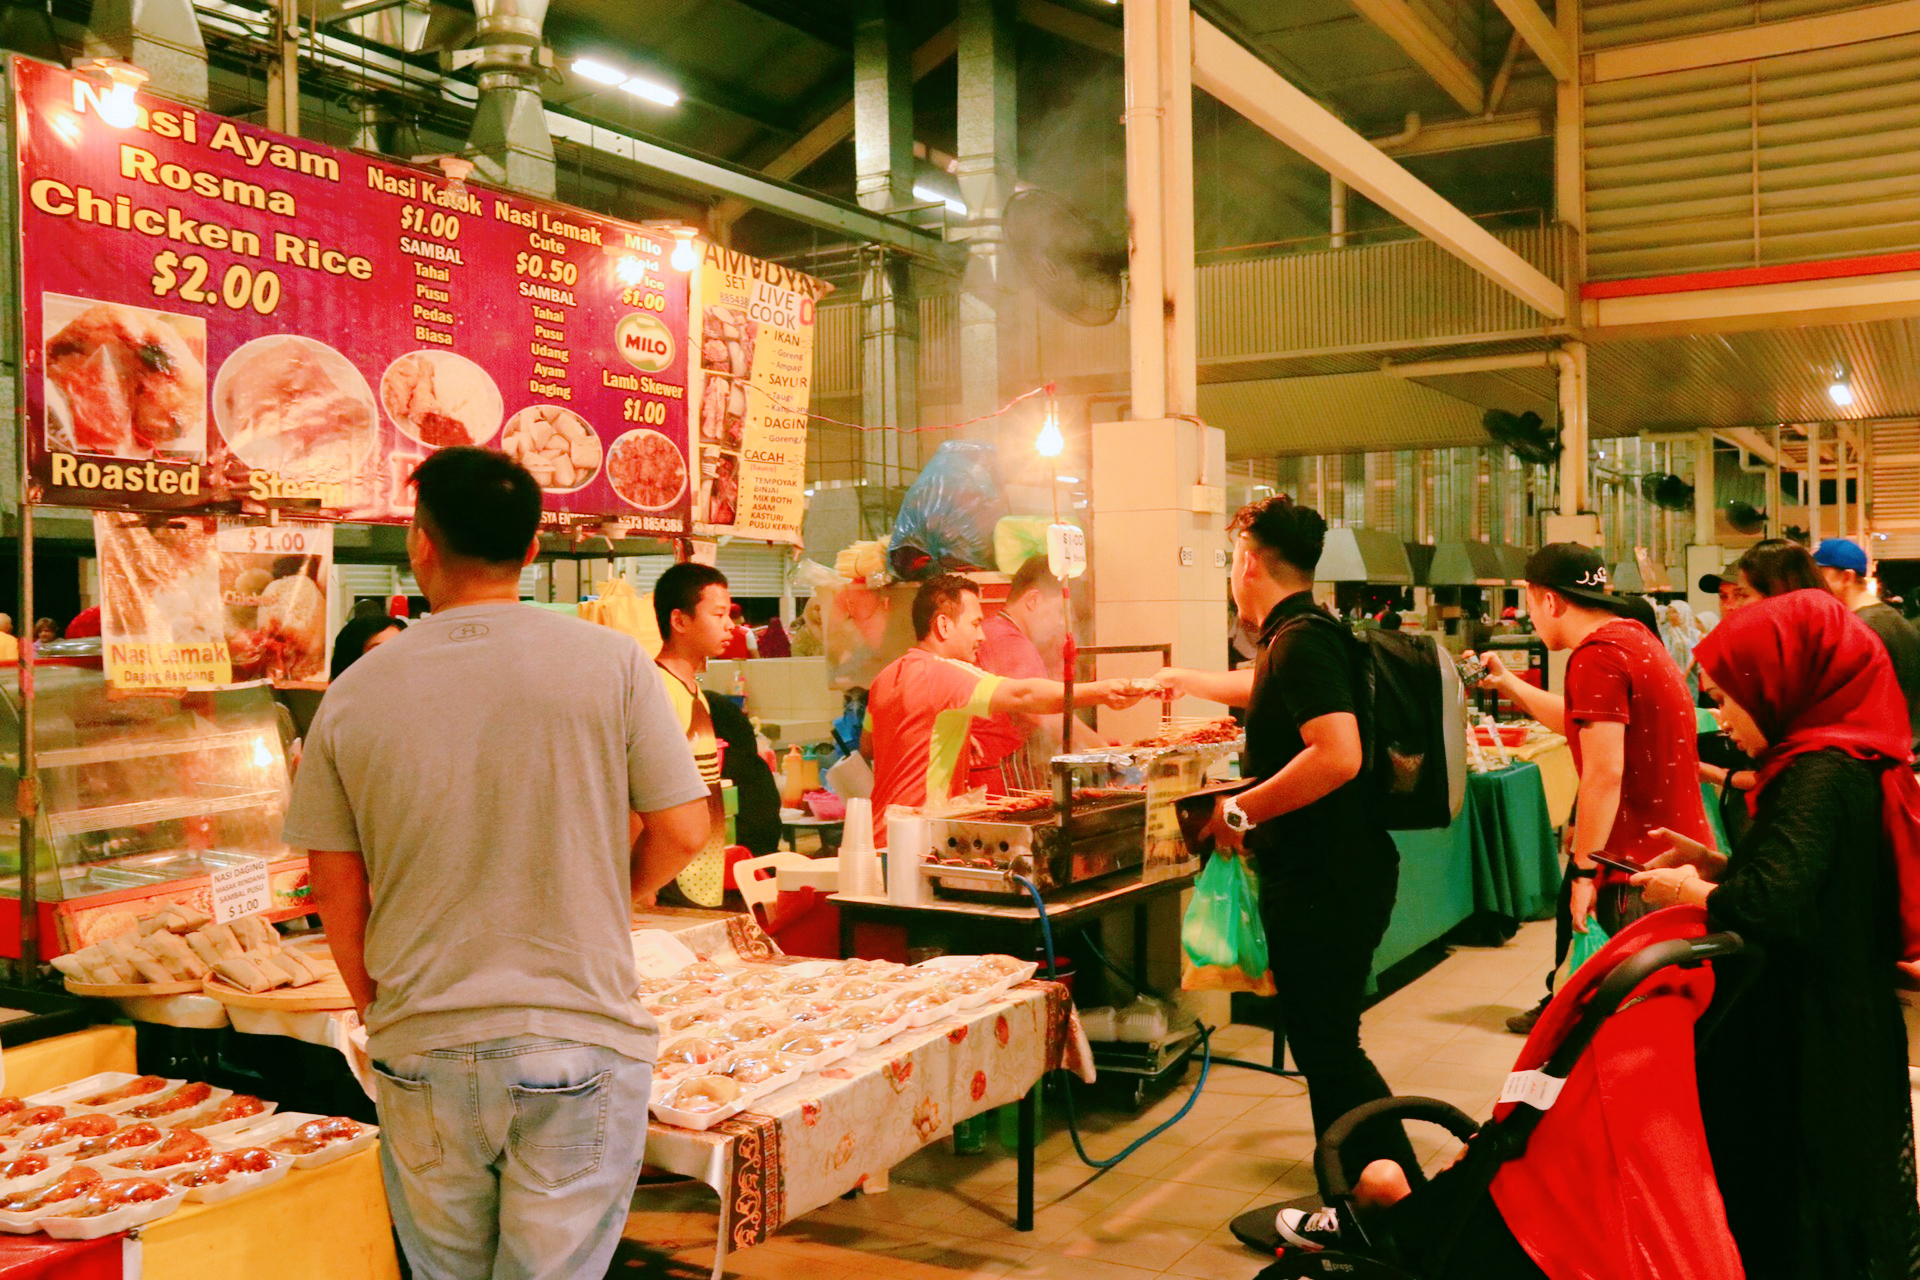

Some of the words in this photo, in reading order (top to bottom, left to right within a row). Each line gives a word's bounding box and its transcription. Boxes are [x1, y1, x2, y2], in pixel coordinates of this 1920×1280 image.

[209, 122, 340, 182] Ayam
[120, 145, 296, 217] Rosma
[367, 166, 416, 199] Nasi
[30, 180, 260, 256] Chicken
[275, 232, 373, 280] Rice
[401, 205, 460, 240] $1.00
[495, 201, 537, 229] Nasi
[542, 214, 602, 246] Lemak
[400, 237, 464, 265] SAMBAL
[529, 233, 565, 254] Cute
[624, 233, 662, 256] Milo
[414, 262, 449, 281] Tahai
[516, 252, 577, 286] $0.50
[152, 250, 281, 314] $2.00
[645, 275, 665, 291] Ice
[725, 274, 745, 290] SET
[416, 284, 449, 302] Pusu
[519, 282, 577, 306] SAMBAL
[623, 288, 665, 313] $1.00
[759, 284, 794, 310] LIVE
[413, 304, 454, 324] Pedas
[532, 305, 564, 323] Tahai
[750, 303, 796, 330] COOK
[415, 326, 453, 345] Biasa
[535, 325, 564, 341] Pusu
[774, 330, 800, 347] IKAN
[531, 342, 569, 363] Udang
[625, 334, 667, 355] MILO
[778, 349, 803, 361] Goreng
[534, 362, 566, 379] Ayam
[769, 374, 807, 388] SAYUR
[530, 380, 571, 400] Daging
[603, 369, 638, 391] Lamb
[641, 376, 684, 399] Skewer
[624, 398, 666, 425] $1.00
[744, 449, 784, 462] CACAH
[52, 453, 200, 496] Roasted
[755, 477, 797, 487] TEMPOYAK
[752, 503, 775, 511] ASAM
[753, 494, 769, 502] MIX
[771, 496, 792, 504] BOTH
[749, 520, 771, 530] PUSU
[751, 512, 783, 521] KASTURI
[248, 529, 257, 552] $
[264, 531, 305, 551] 1.00
[111, 644, 152, 665] Nasi
[159, 643, 227, 664] Lemak
[214, 872, 232, 883] NASI
[234, 861, 265, 877] DAGING
[220, 890, 246, 904] SAMBAL
[247, 884, 264, 894] PUSU
[229, 906, 235, 918] $
[239, 899, 259, 914] 1.00
